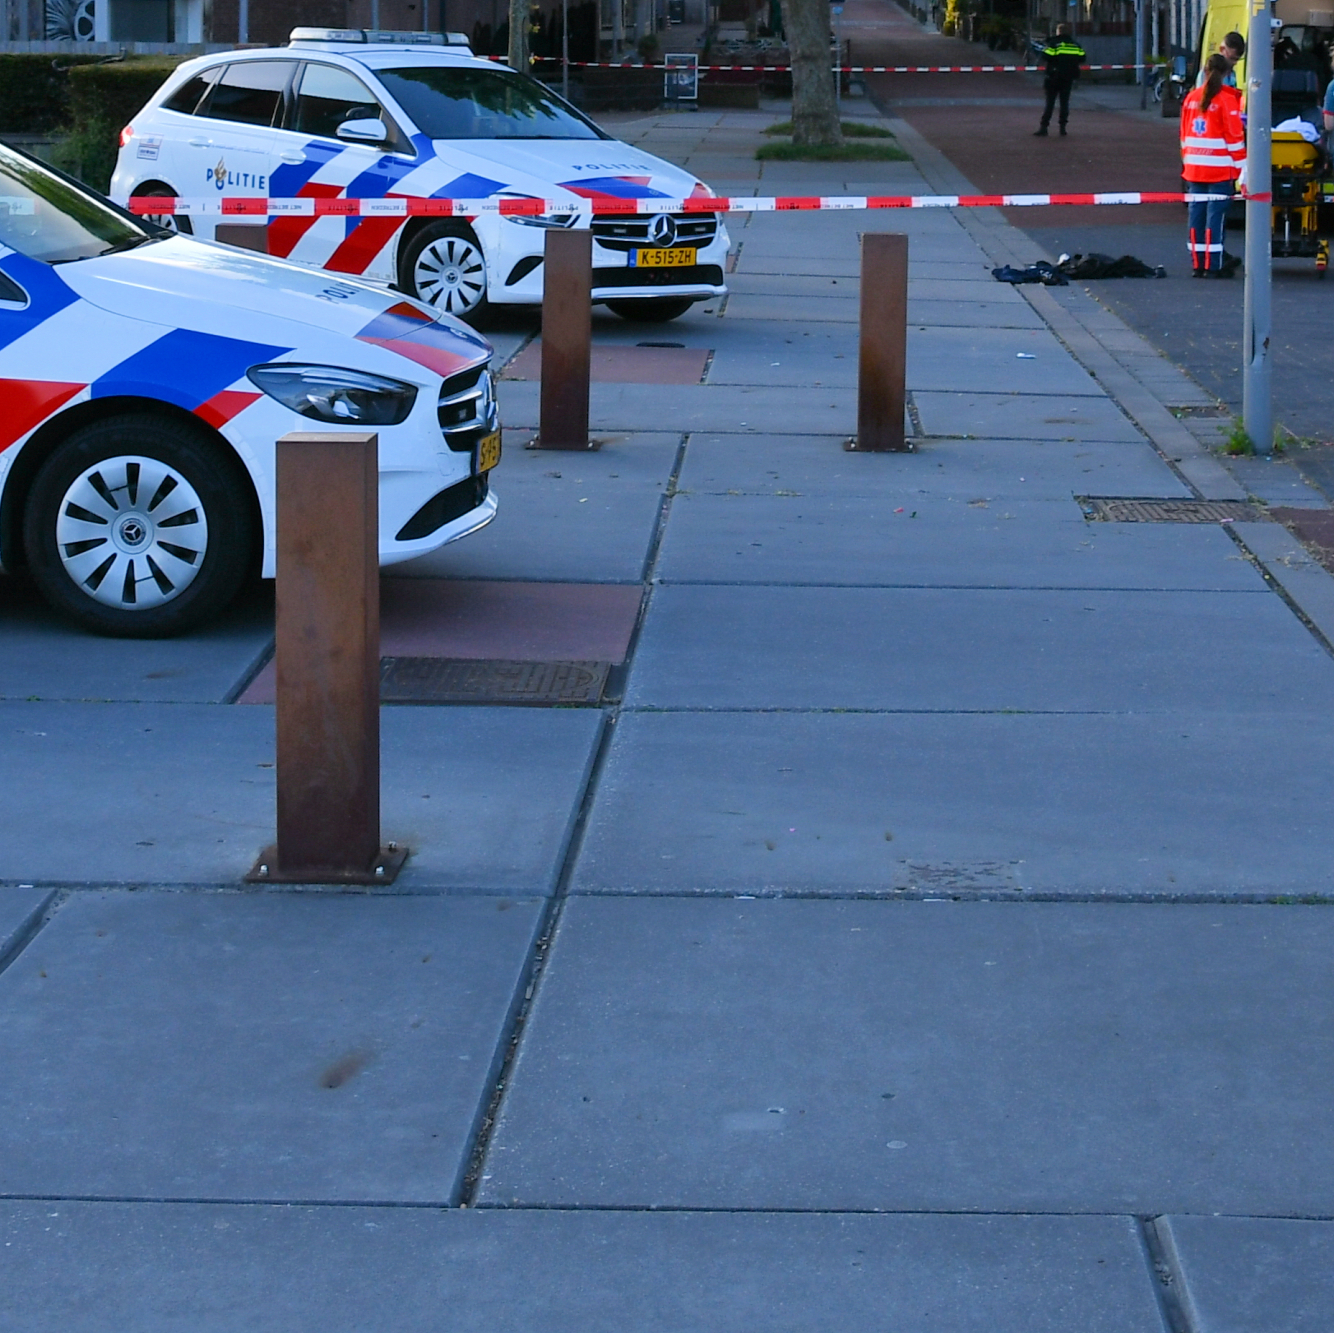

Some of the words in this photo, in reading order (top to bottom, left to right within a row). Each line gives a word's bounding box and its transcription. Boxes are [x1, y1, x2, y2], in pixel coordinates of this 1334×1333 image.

[571, 163, 652, 171] POLITIE
[206, 168, 266, 191] POLITIE
[642, 249, 692, 265] K-515-ZH
